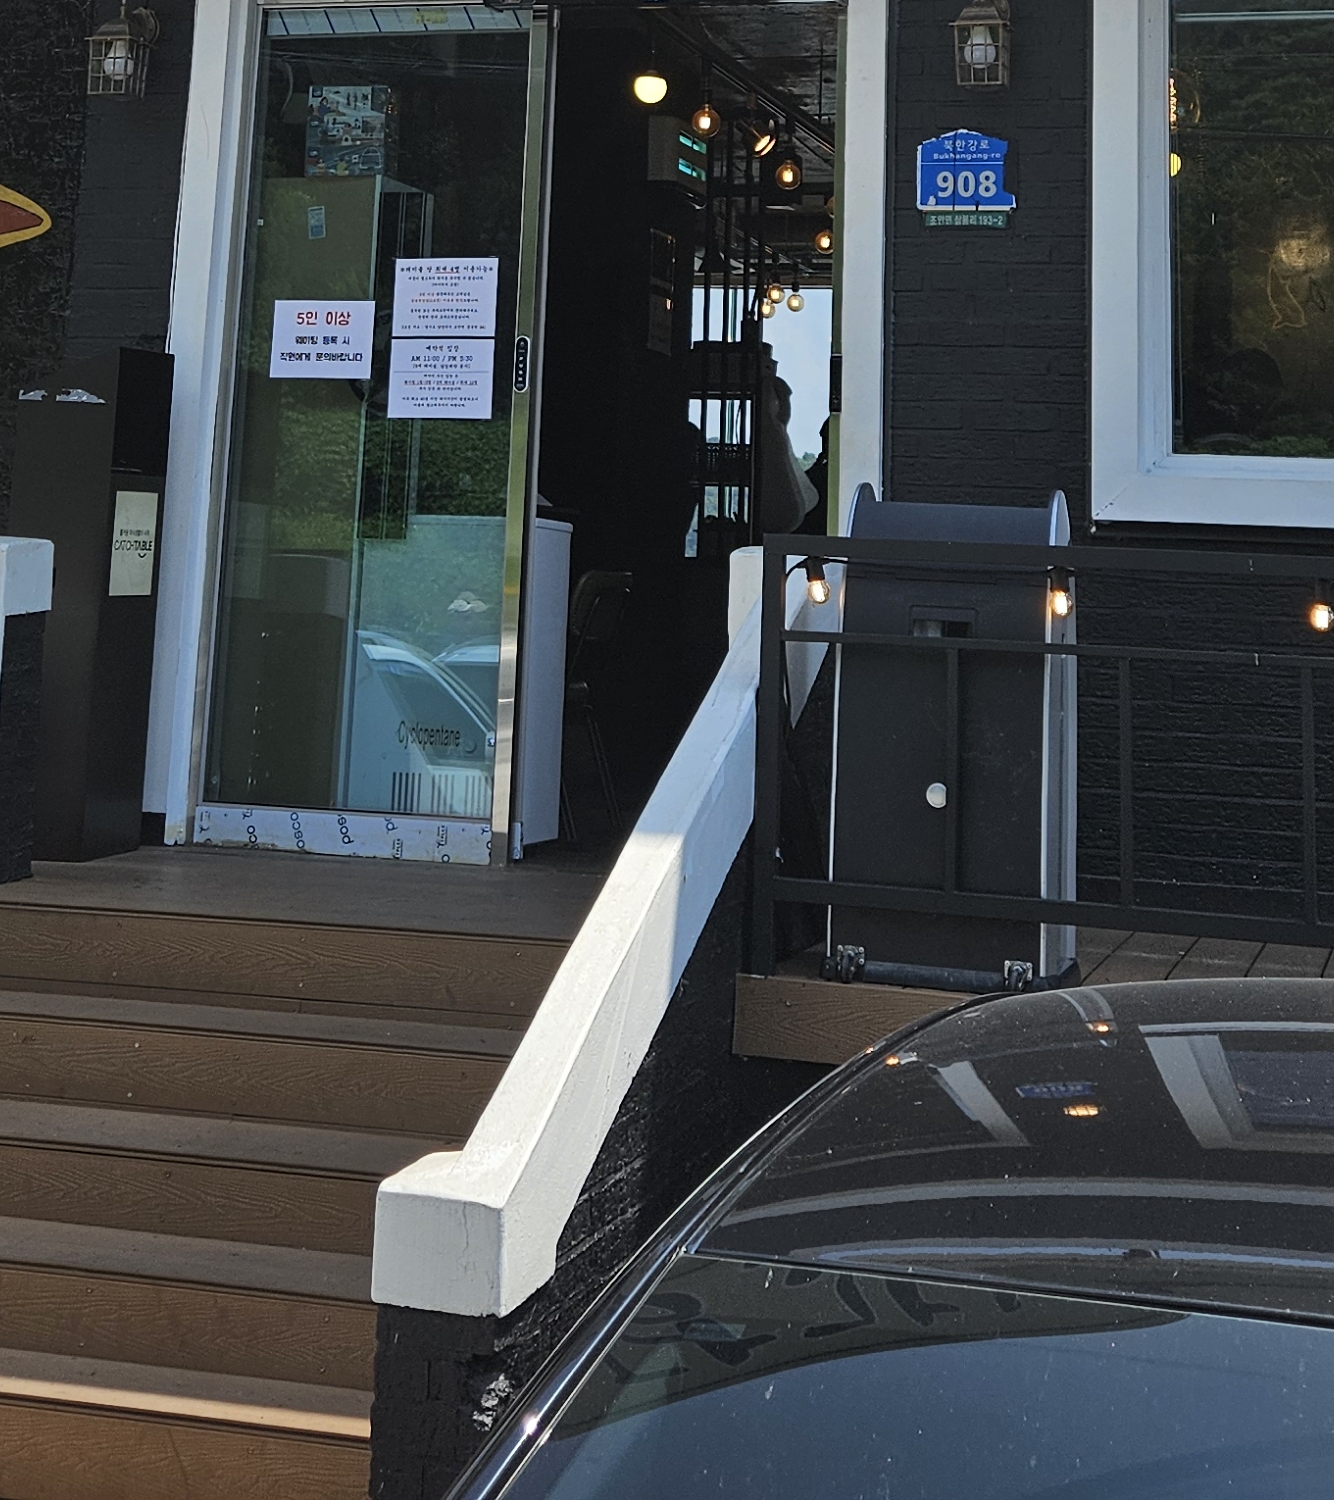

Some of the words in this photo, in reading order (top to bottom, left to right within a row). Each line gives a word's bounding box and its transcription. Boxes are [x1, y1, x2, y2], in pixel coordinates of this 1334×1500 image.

[943, 140, 990, 152] 북한강로
[933, 152, 1001, 161] Bukhangang-ro
[936, 170, 997, 198] 908
[296, 311, 318, 326] 5인
[325, 311, 351, 326] 이상
[295, 335, 318, 345] 웨이팅
[322, 336, 338, 345] 등록
[342, 336, 350, 345] 시
[280, 352, 311, 362] 직원에게
[315, 352, 363, 362] 문의바랍니다
[398, 720, 460, 751] Cyclopentane
